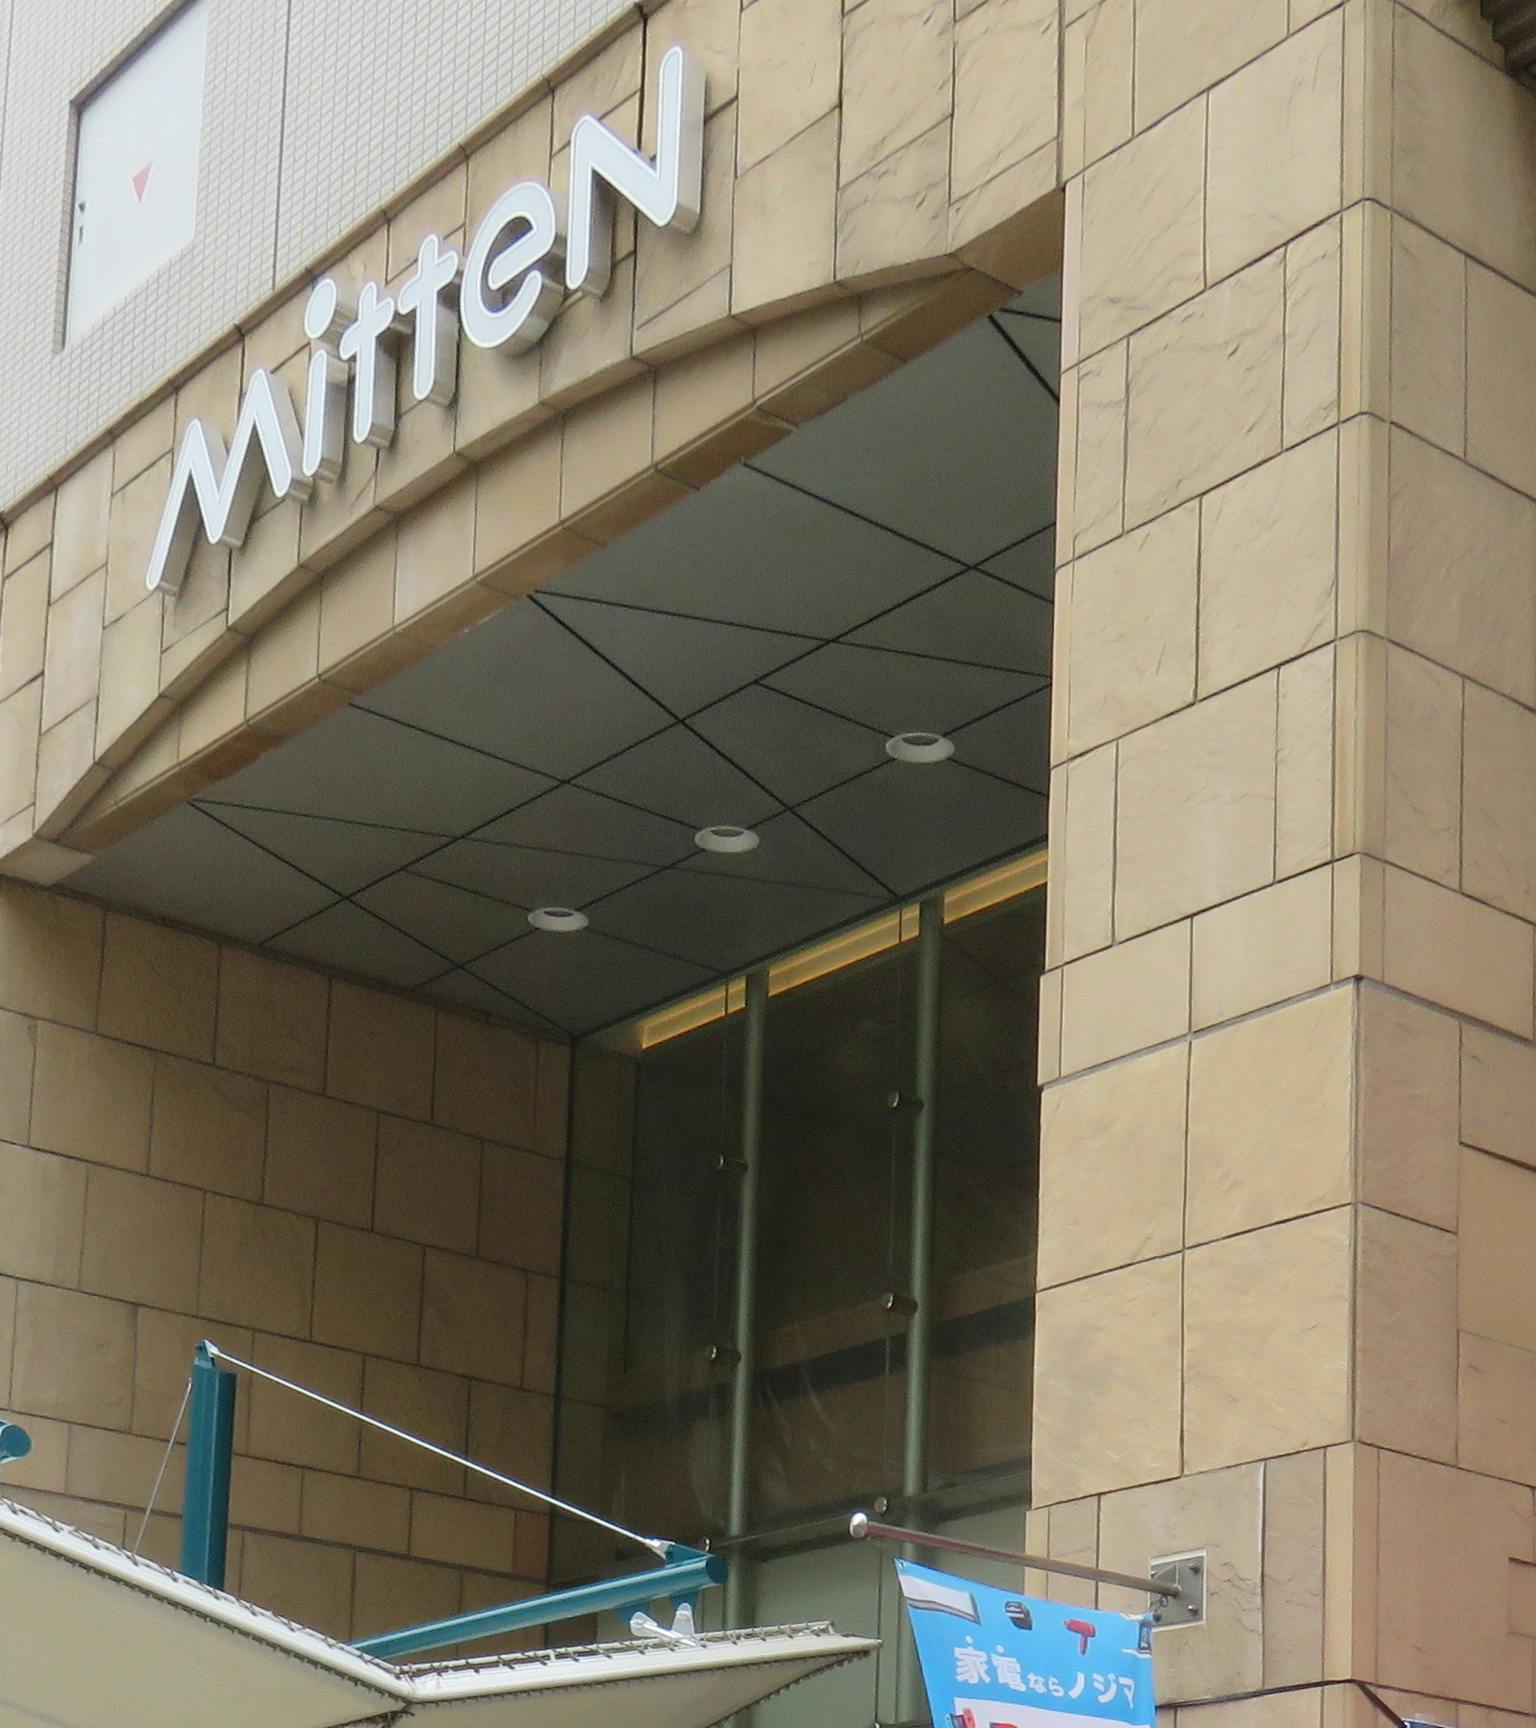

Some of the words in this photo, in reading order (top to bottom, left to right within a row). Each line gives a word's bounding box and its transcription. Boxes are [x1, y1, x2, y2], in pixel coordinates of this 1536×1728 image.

[954, 1636, 1137, 1709] 家電ならノジマ
